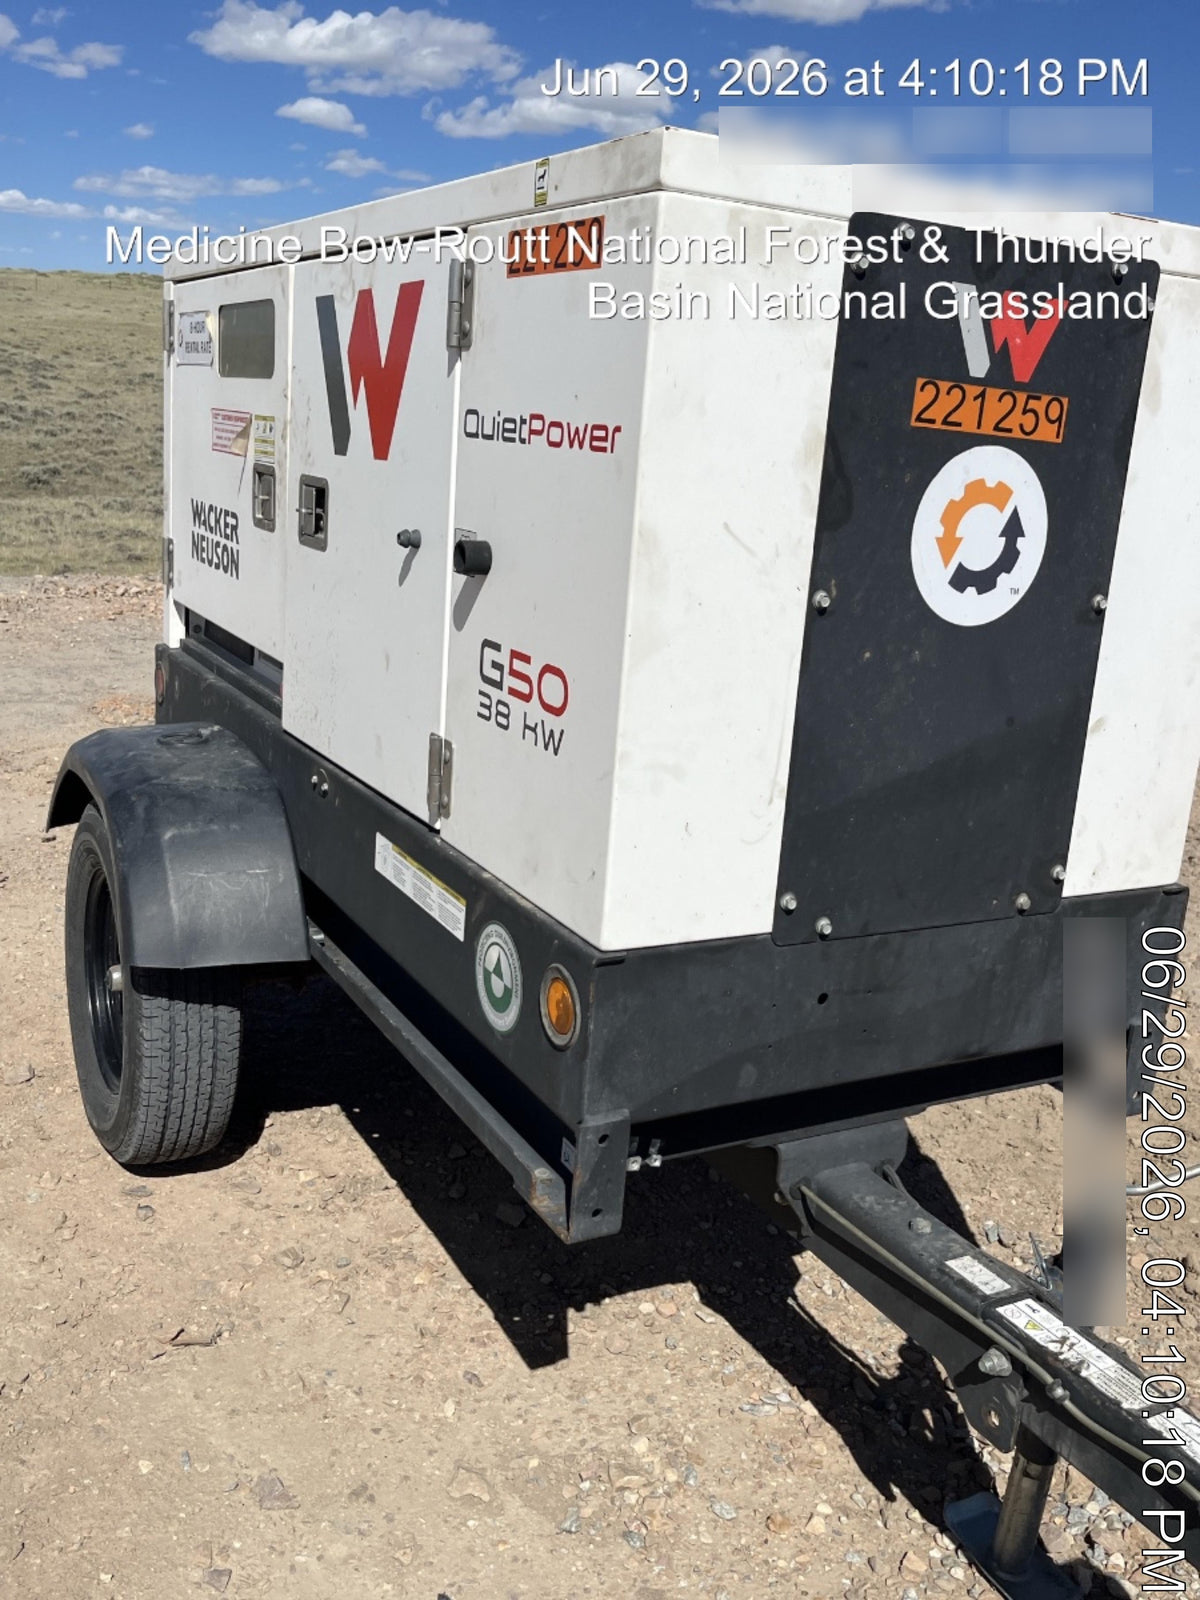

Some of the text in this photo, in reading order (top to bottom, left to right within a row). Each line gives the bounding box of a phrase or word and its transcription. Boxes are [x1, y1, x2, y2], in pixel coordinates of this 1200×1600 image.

[463, 408, 622, 454] QuietPower
[914, 380, 1065, 439] 221259
[190, 497, 240, 545] WACKER
[191, 530, 240, 581] NEUSON
[479, 638, 569, 717] G50
[477, 689, 511, 732] 38
